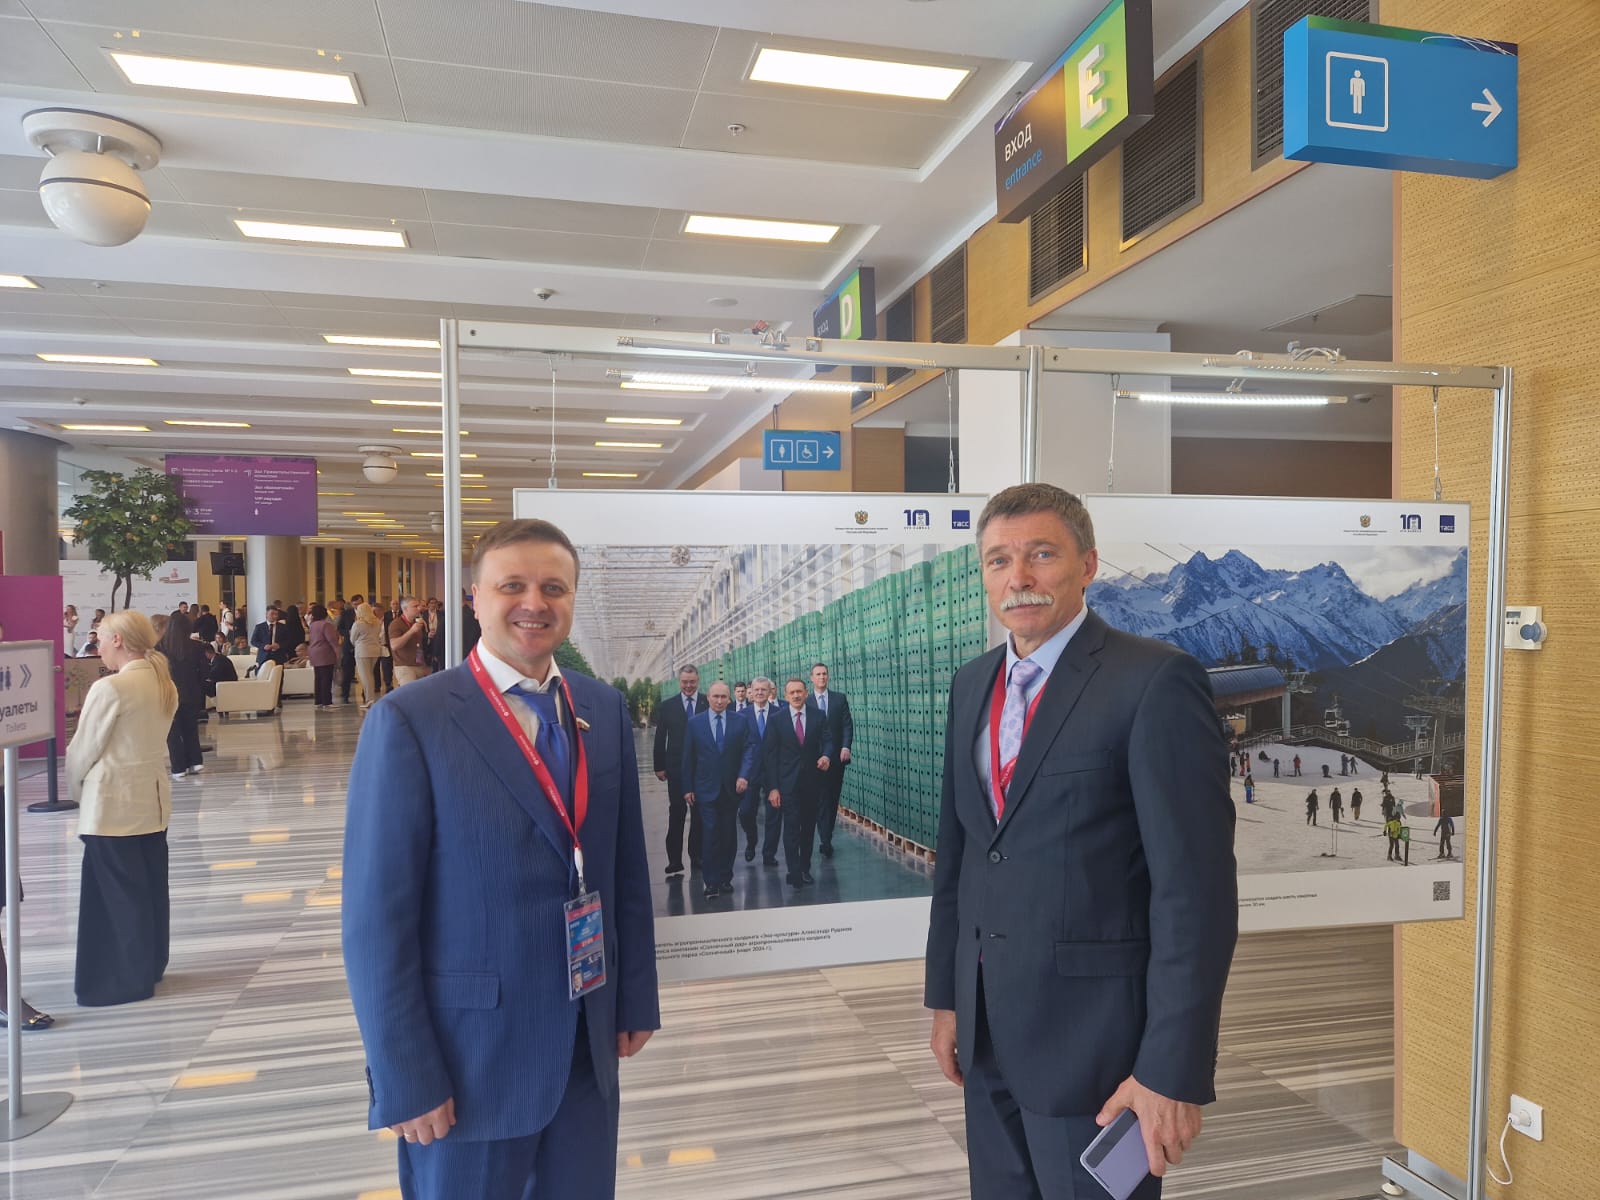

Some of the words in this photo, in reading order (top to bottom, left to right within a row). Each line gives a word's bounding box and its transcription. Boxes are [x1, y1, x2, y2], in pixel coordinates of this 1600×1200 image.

[1078, 43, 1108, 129] E
[1005, 148, 1043, 191] entrance
[841, 294, 853, 336] D
[0, 701, 39, 722] уалеты
